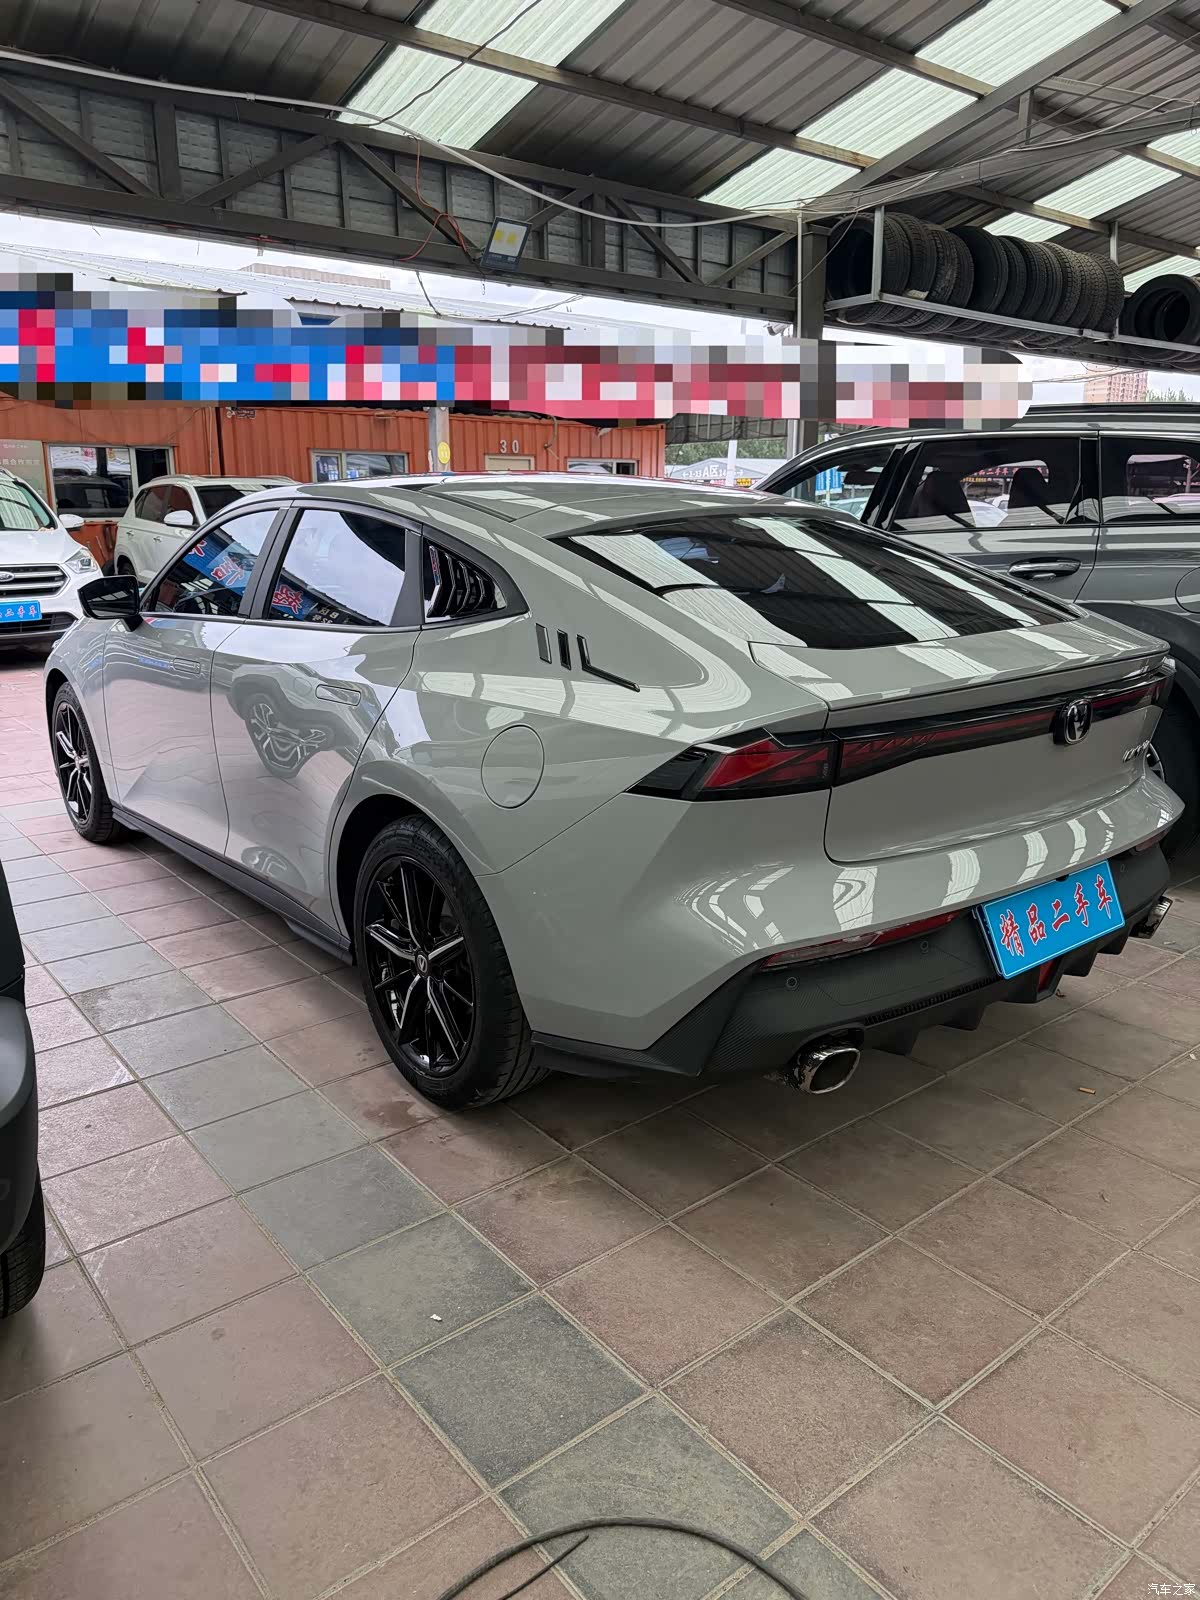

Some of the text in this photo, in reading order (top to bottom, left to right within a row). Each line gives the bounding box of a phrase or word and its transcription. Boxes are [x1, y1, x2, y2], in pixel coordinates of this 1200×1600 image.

[499, 439, 520, 454] 30
[1000, 873, 1113, 957] 精品二手车
